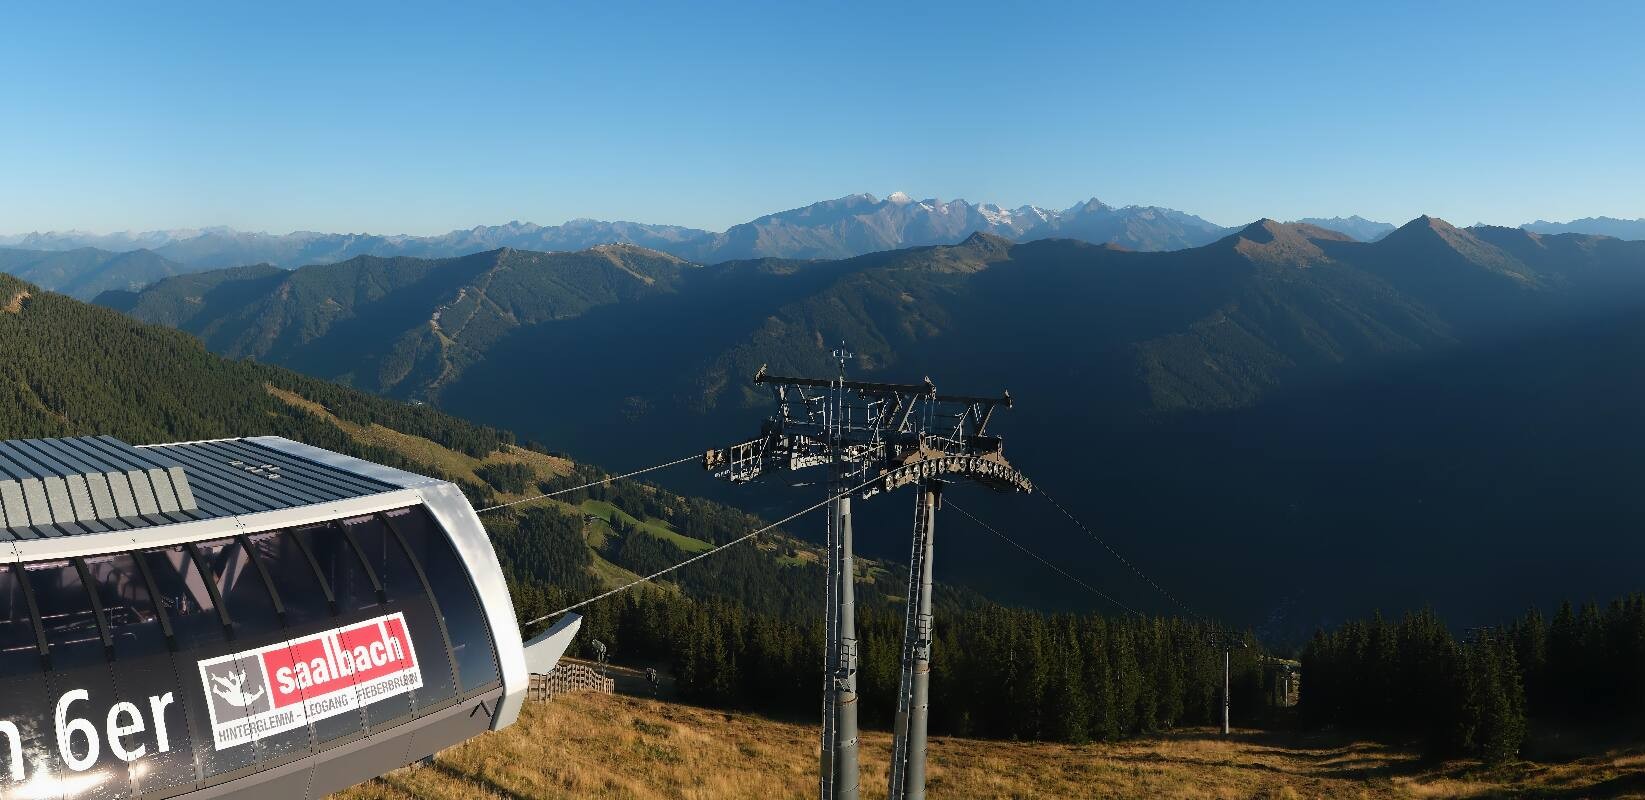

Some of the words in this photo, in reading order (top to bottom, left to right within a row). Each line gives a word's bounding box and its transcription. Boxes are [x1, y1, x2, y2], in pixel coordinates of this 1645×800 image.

[275, 621, 404, 694] saalbach
[55, 688, 174, 772] 6er
[218, 710, 295, 743] HINTERGLEMM
